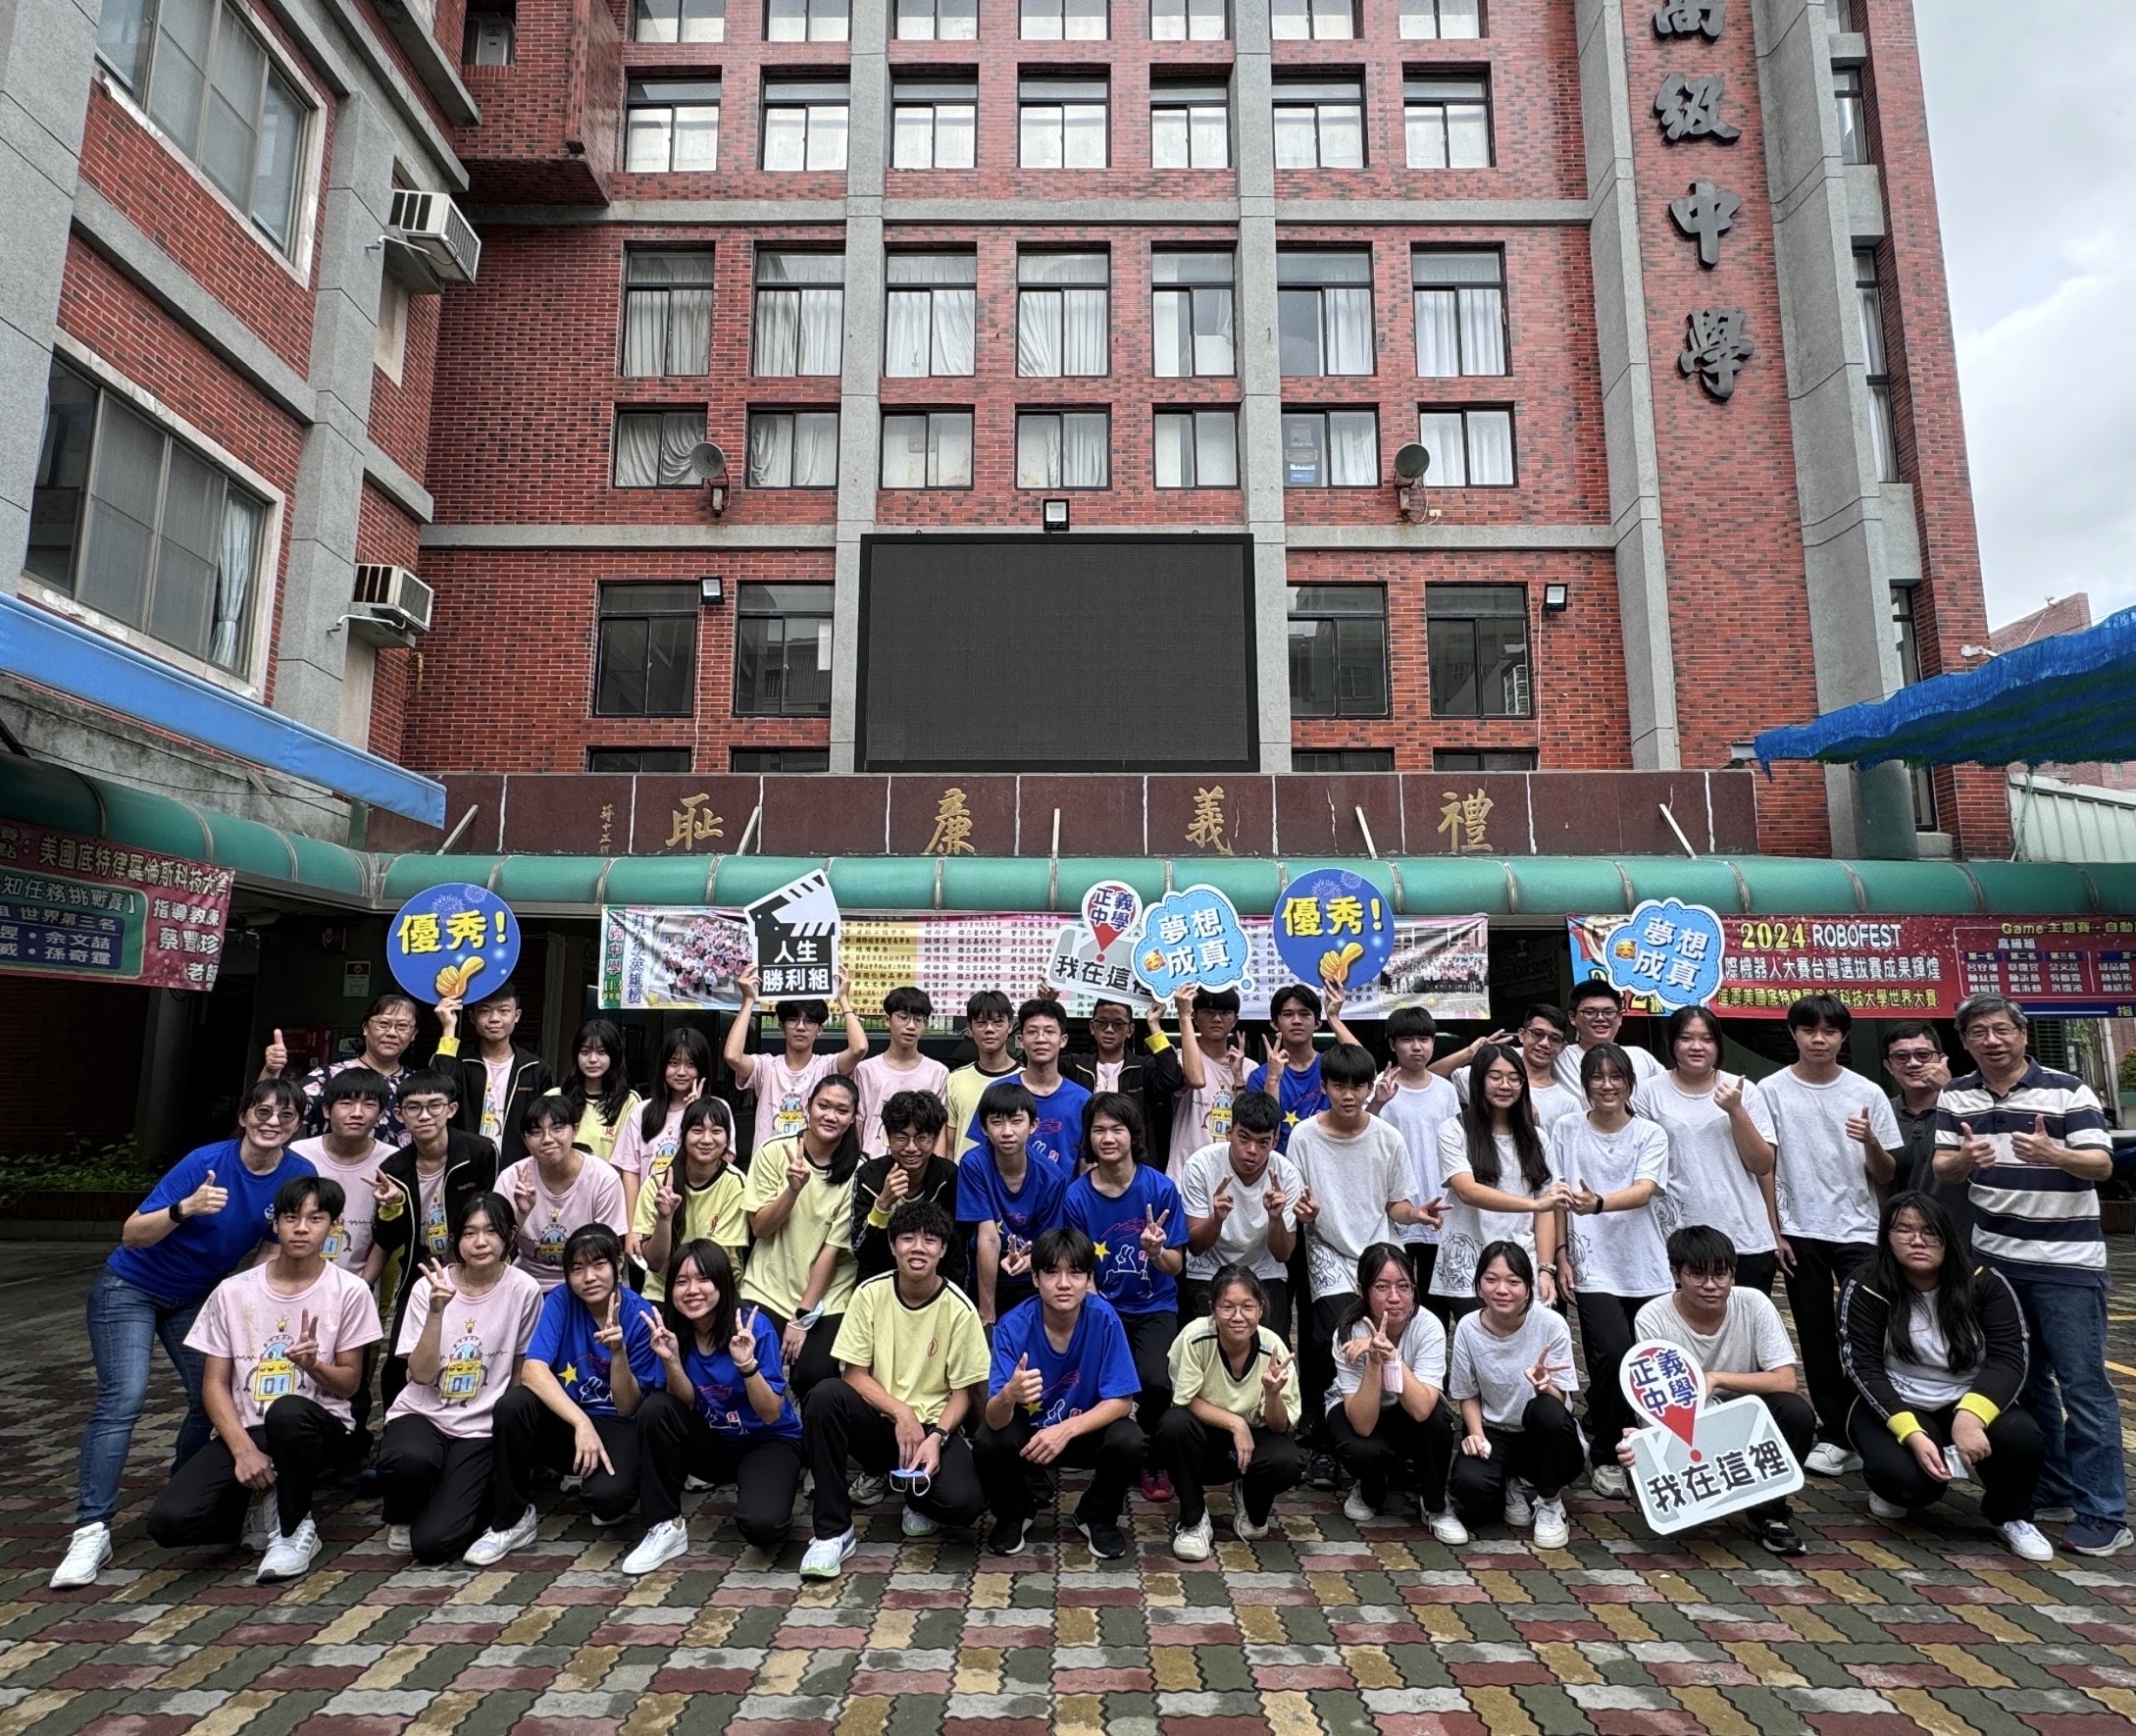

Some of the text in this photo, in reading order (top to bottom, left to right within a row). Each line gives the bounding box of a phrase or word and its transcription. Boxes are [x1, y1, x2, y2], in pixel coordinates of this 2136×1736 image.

[924, 788, 976, 855] 廉
[1185, 785, 1233, 856] 義
[1438, 788, 1494, 852] 禮
[1090, 907, 1131, 931] 中學
[1093, 887, 1136, 913] 正義
[1158, 906, 1222, 946] 夢想
[1643, 916, 1709, 960] 夢想
[1740, 922, 1903, 950] 2024 ROBOFEST
[2002, 922, 2044, 934] Game
[774, 939, 819, 964] 人生
[1164, 941, 1231, 979] 成真
[1632, 948, 1701, 993] 成真
[762, 968, 831, 993] 勝利組
[1718, 987, 1937, 1007] 進軍美國底特律科技大學世界大賽
[1628, 1348, 1688, 1388] 正義
[1643, 1377, 1698, 1415] 中學
[1647, 1439, 1790, 1513] 我在這裡
